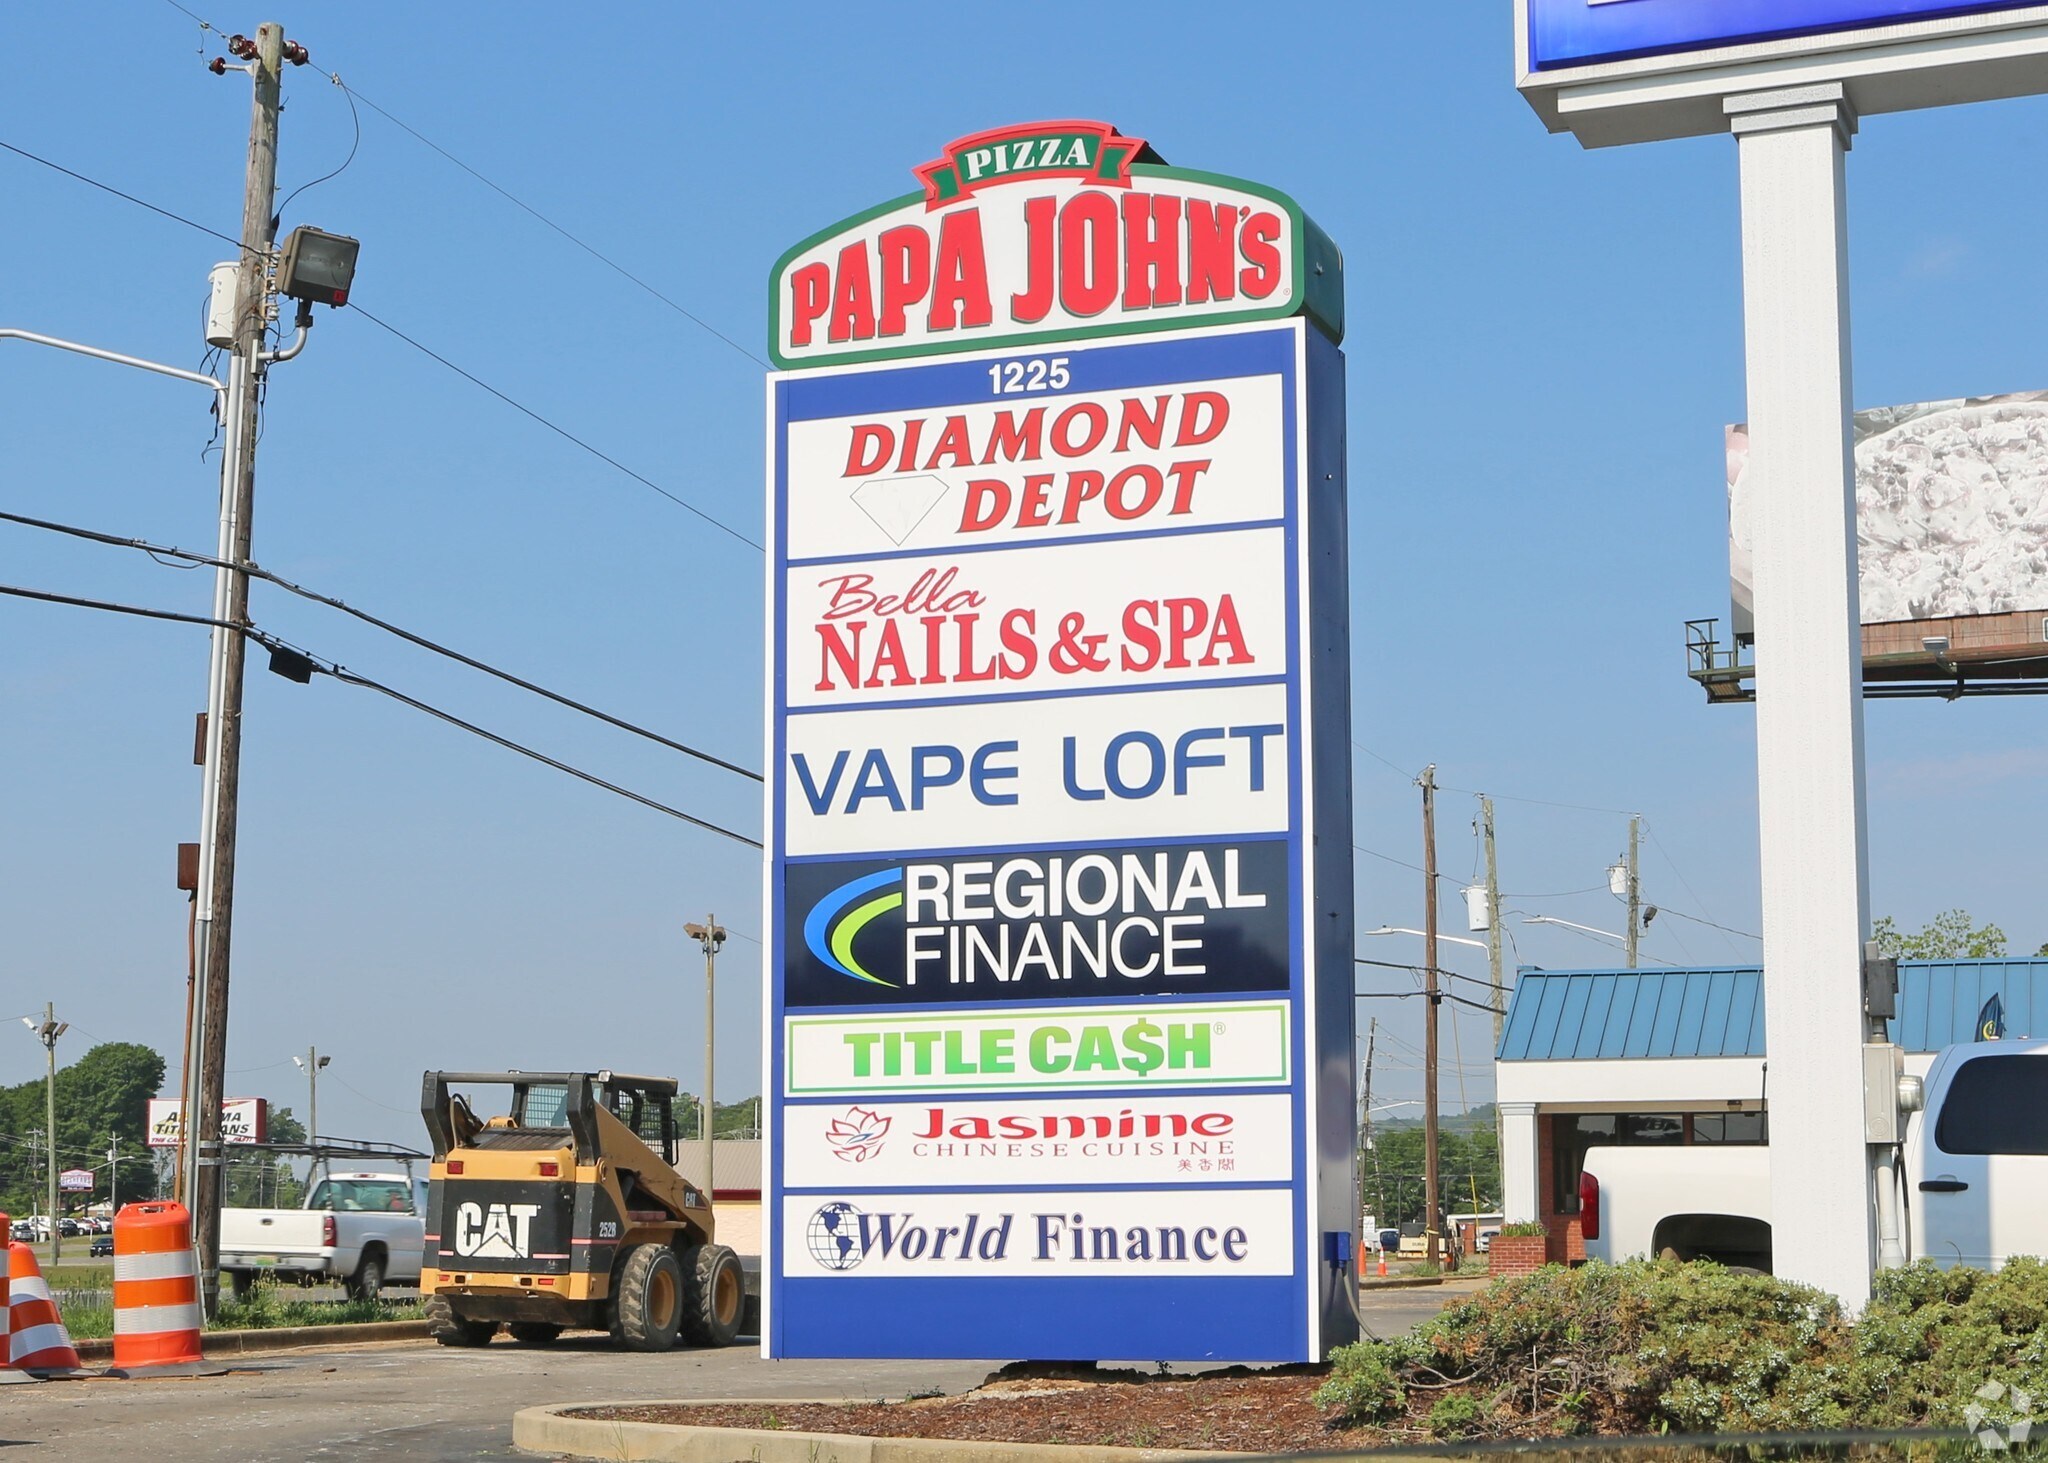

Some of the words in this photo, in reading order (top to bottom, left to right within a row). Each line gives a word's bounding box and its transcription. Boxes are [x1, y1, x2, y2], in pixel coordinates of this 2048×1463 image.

[964, 138, 1091, 181] PIZZA
[790, 206, 993, 348] PAPA
[1010, 190, 1281, 324] JOHN'S
[988, 357, 1070, 395] 1225
[841, 391, 1230, 479] DIAMOND
[954, 459, 1212, 534] DEPOT
[817, 566, 987, 621] Bella
[814, 608, 1038, 692] NAILS
[1048, 611, 1110, 675] &
[1120, 593, 1256, 673] SPA
[790, 740, 1019, 816] VAPE
[1062, 723, 1285, 801] LOFT
[905, 848, 1267, 923] REGIONAL
[905, 914, 1207, 986] FINANCE
[843, 1028, 1016, 1077] TITLE
[912, 1108, 1234, 1141] Jasmine
[912, 1143, 1068, 1157] CHINESE
[1082, 1140, 1235, 1157] CUISINE
[456, 1202, 538, 1259] CAT
[857, 1212, 1016, 1263] World
[1030, 1212, 1249, 1264] Finance
